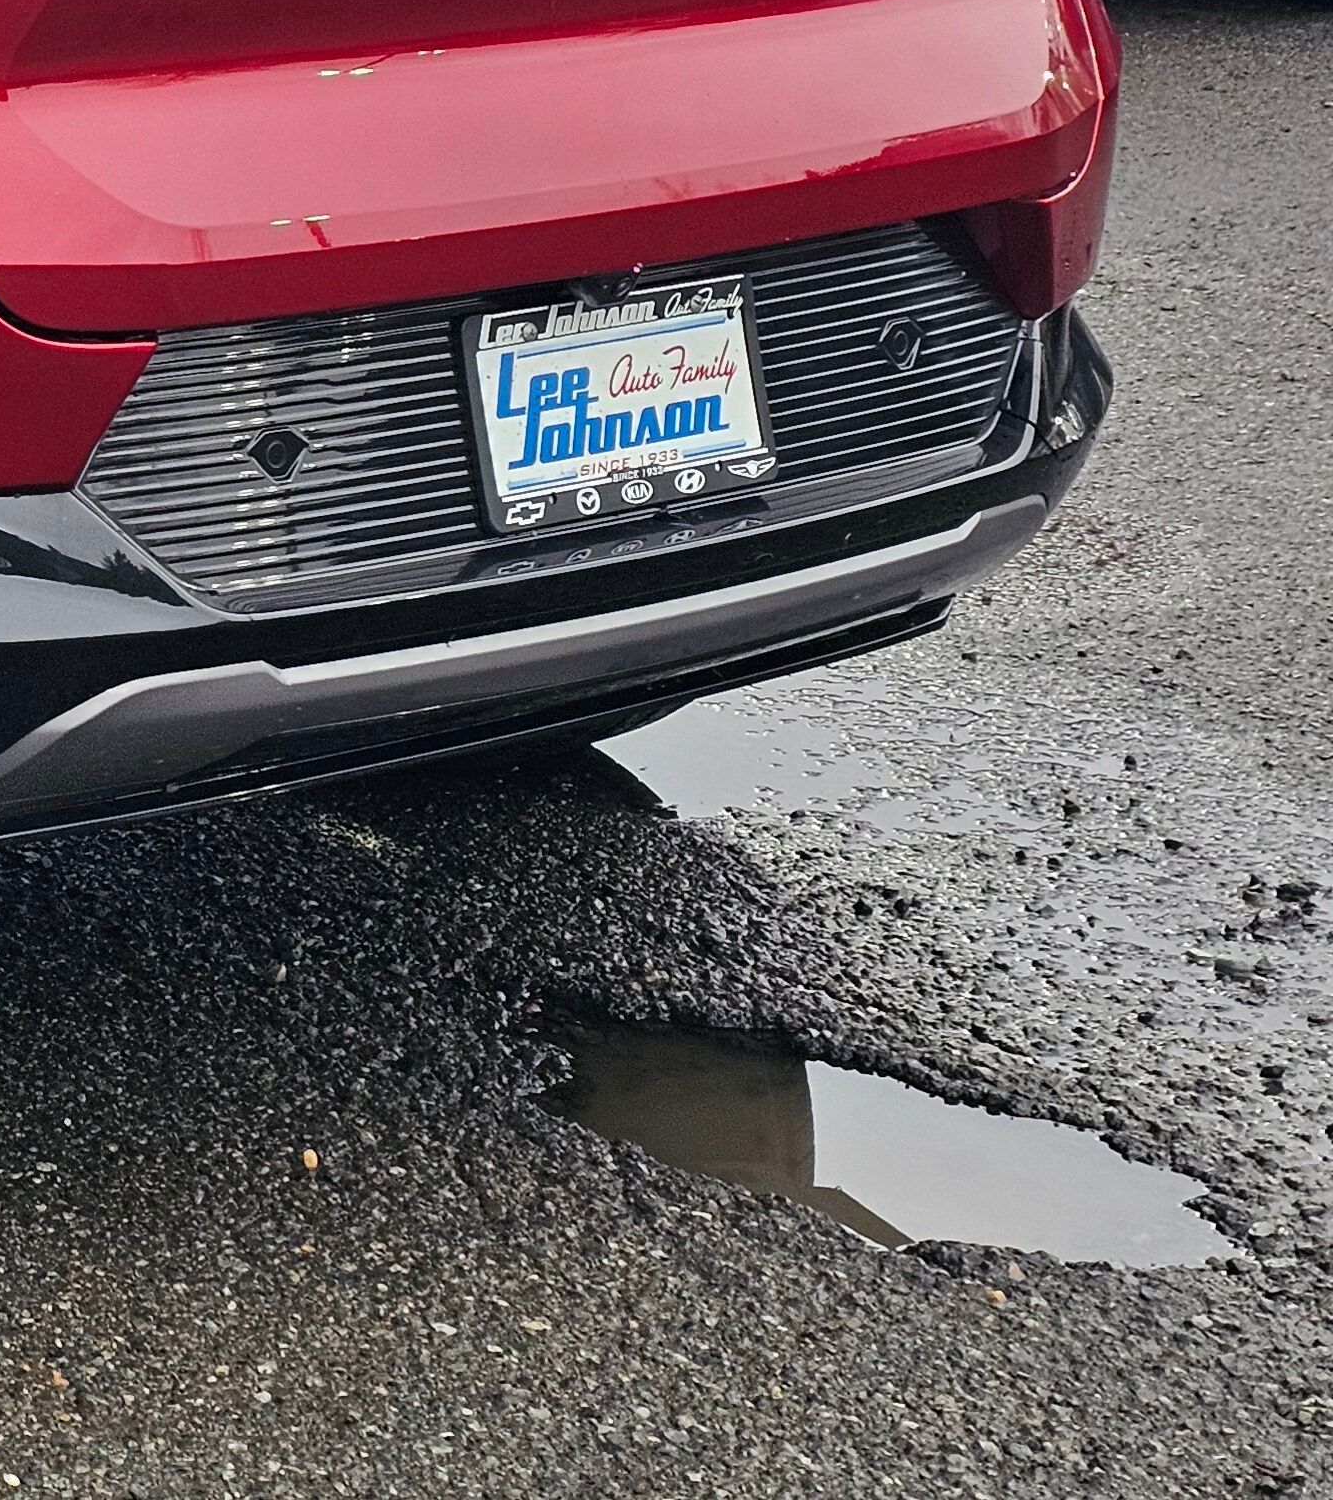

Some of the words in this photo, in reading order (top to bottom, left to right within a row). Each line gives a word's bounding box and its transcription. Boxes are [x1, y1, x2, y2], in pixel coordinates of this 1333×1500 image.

[537, 299, 658, 340] Johnson
[664, 291, 694, 319] Aut
[697, 283, 745, 317] Family
[497, 351, 599, 419] Lee
[609, 353, 663, 398] Auto
[663, 338, 738, 394] Family
[508, 391, 731, 470] Johnson
[580, 457, 632, 477] SINCE
[640, 448, 679, 467] 1933
[613, 469, 640, 483] SINCE
